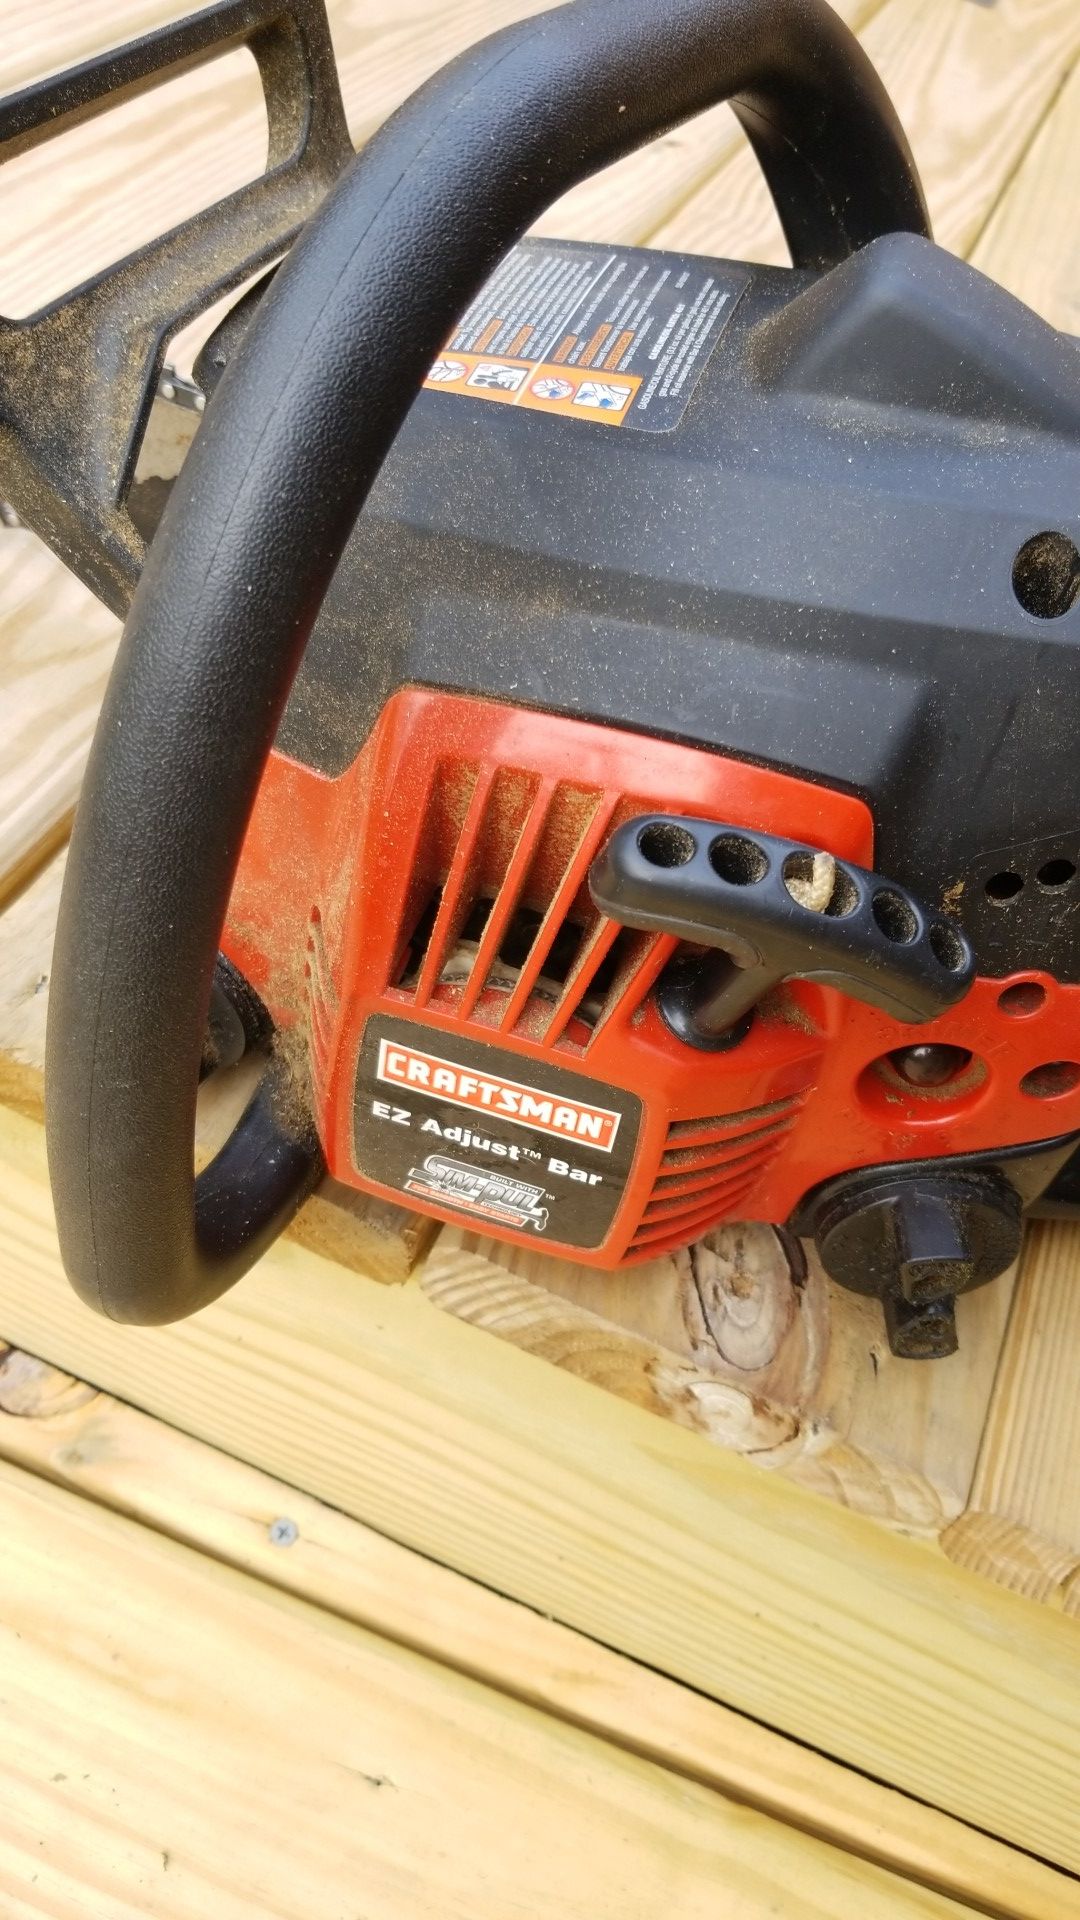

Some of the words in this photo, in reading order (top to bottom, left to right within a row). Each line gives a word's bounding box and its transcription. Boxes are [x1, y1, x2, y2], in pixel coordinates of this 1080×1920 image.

[372, 1101, 412, 1126] EZ
[547, 1157, 603, 1186] Bar
[489, 1174, 514, 1186] BUILT
[516, 1182, 540, 1194] WITH
